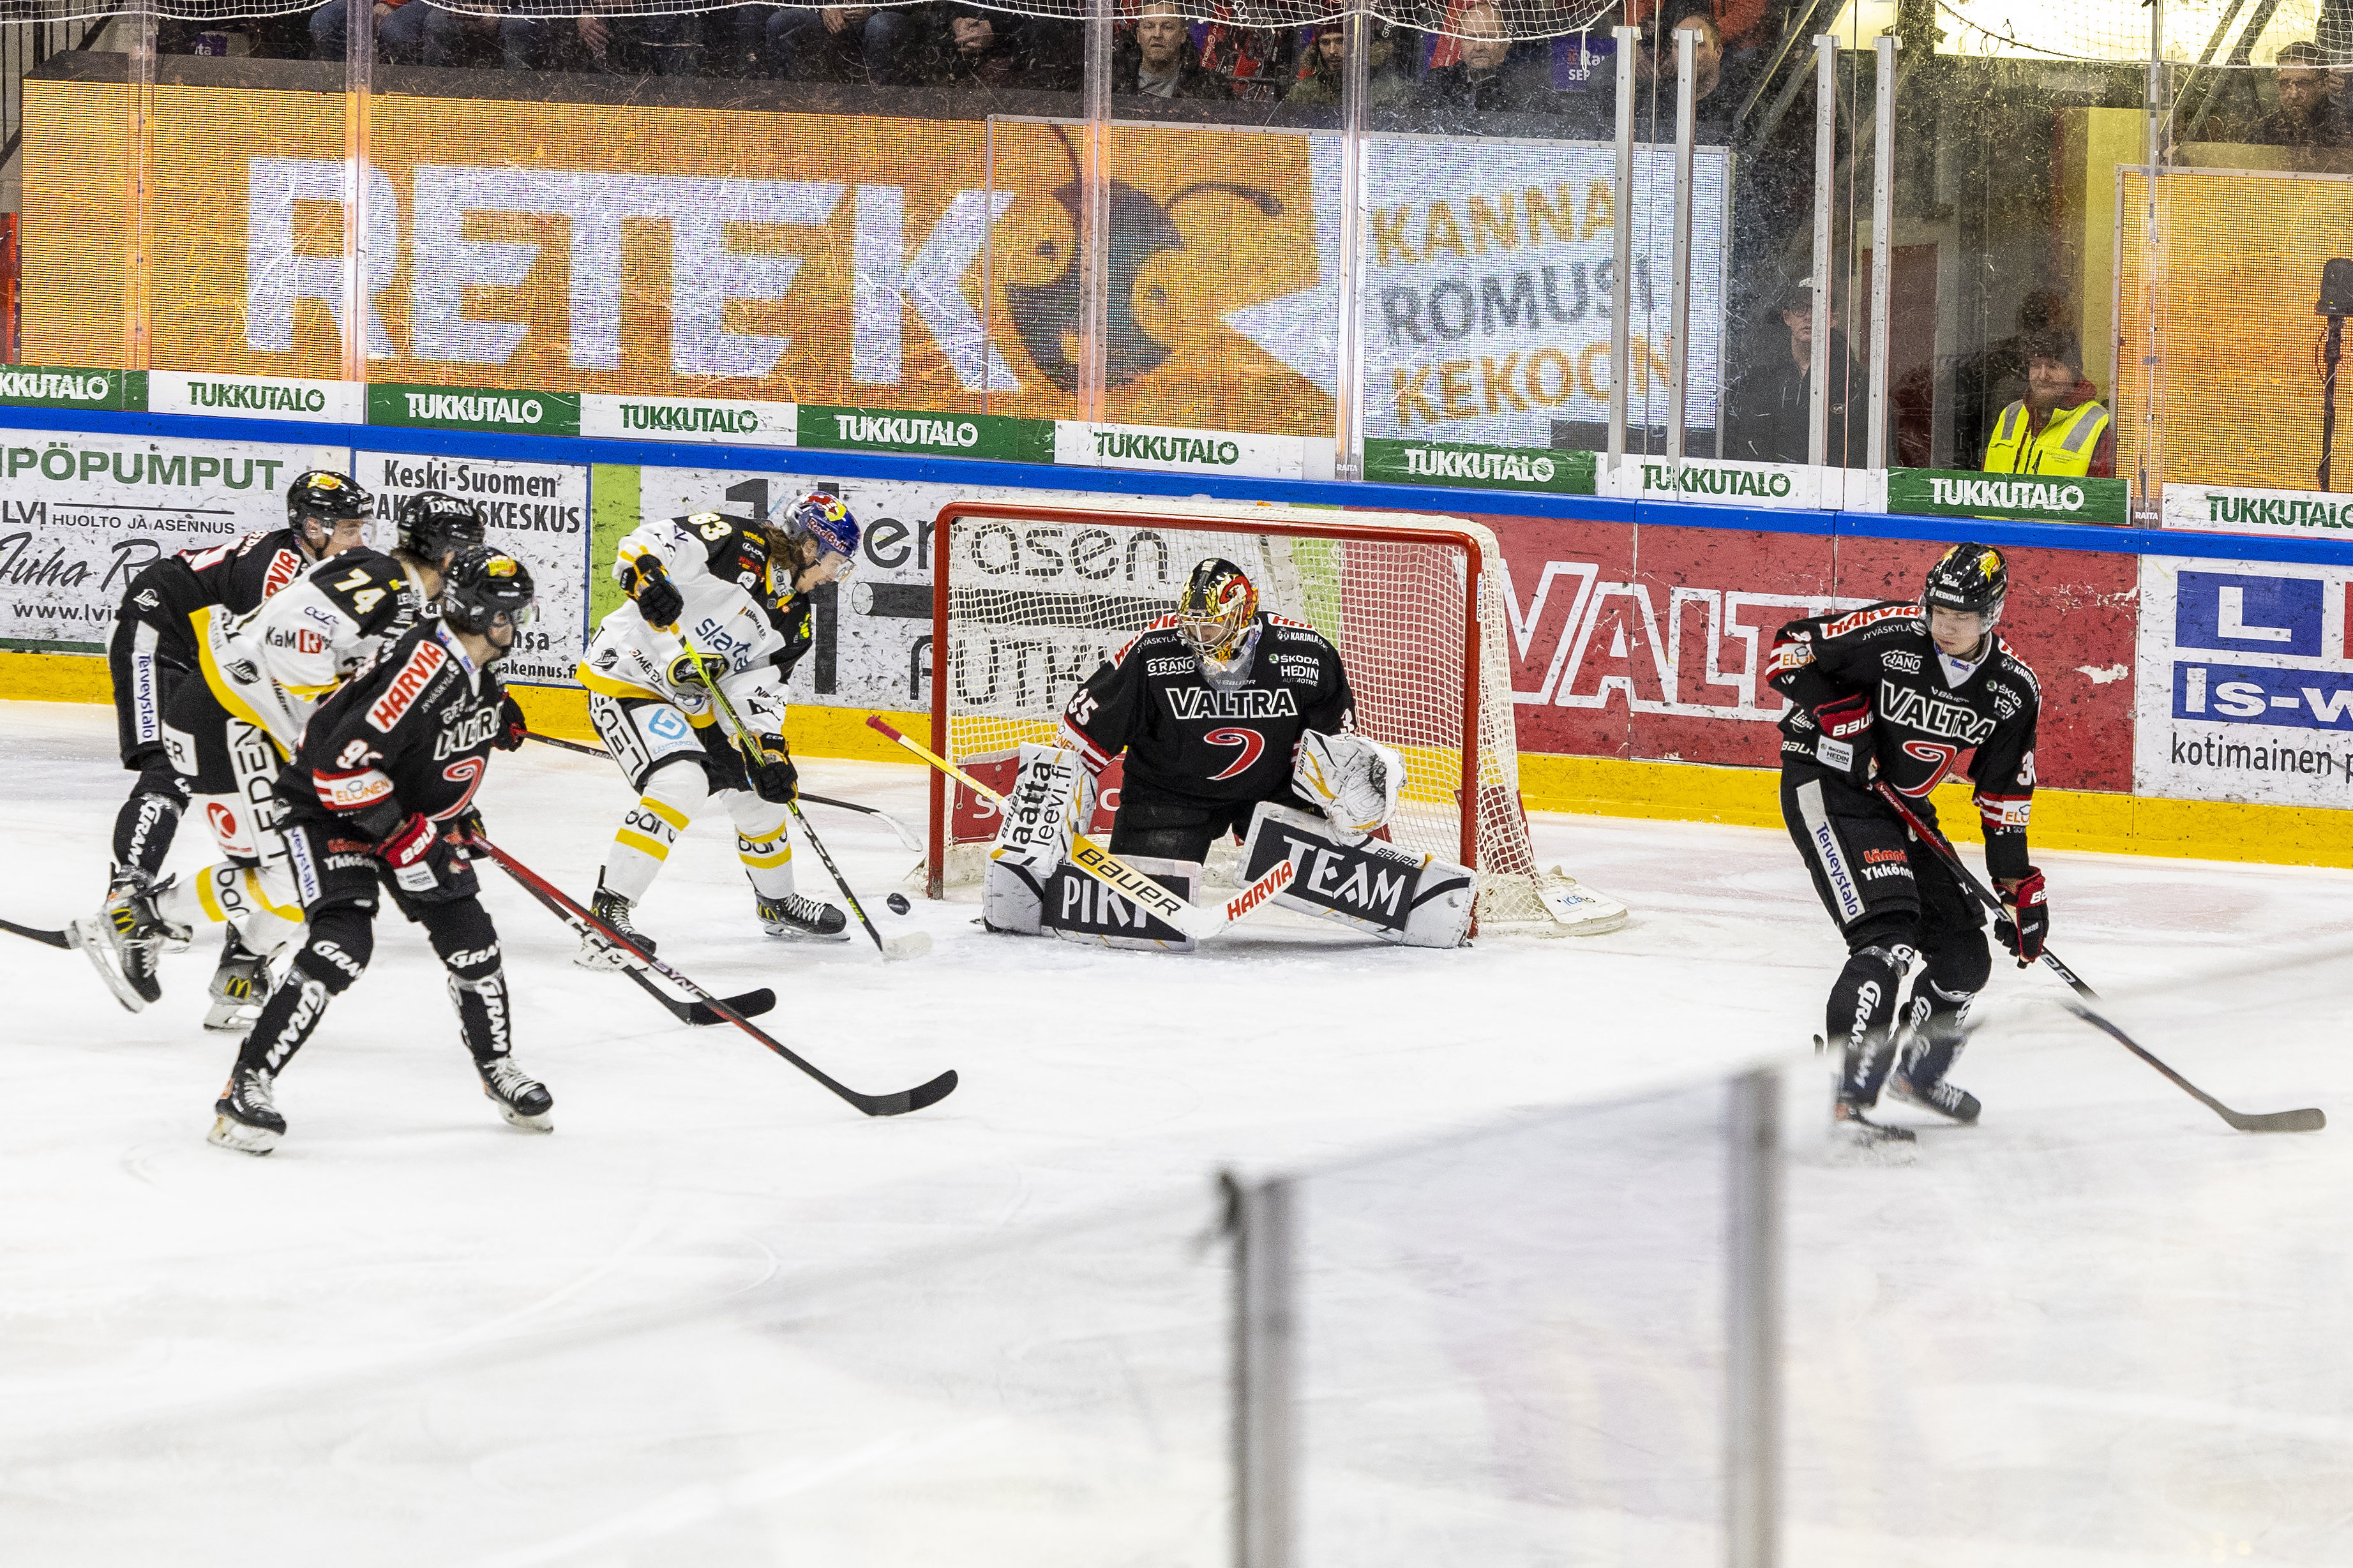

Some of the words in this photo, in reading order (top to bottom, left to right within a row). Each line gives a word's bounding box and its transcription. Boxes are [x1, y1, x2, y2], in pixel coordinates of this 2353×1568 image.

[1372, 180, 1616, 267] KANNA
[246, 156, 1021, 393] RETEK
[1380, 252, 1655, 346] ROMUSI
[0, 372, 109, 400] KKUTALO
[188, 382, 325, 412] TUKKUTALO
[405, 392, 543, 424] TUKKUTALO
[619, 403, 758, 435] TUKKUTALO
[833, 415, 979, 448] TUKKUTALO
[1093, 432, 1240, 465] TUKKUTALO
[0, 442, 283, 491] PÖPUMPUT
[384, 459, 556, 498] Keski-Suomen
[1404, 449, 1555, 482] TUKKUTALO
[1643, 464, 1791, 498] TUKKUTALO
[1930, 477, 2086, 512] TUKKUTALO
[2, 501, 47, 525] LVI
[53, 514, 121, 529] HUOLTO
[127, 519, 148, 530] JA
[153, 519, 235, 535] ASENNUS
[688, 511, 733, 541] 63
[333, 568, 387, 615] 74
[1290, 632, 1319, 645] KARJALA
[1826, 606, 1923, 638] HARVIA
[1862, 623, 1912, 641] JYVÄSKYLÄ
[1497, 558, 1881, 722] VALT
[1148, 659, 1195, 673] GRANO
[1280, 653, 1319, 666] ŠKODA
[1281, 665, 1319, 680] HEDIN
[137, 653, 156, 739] Terveystalo
[373, 641, 446, 730] HARVIA
[1068, 688, 1099, 726] 35
[1165, 686, 1298, 720] VALTRA
[1882, 678, 1997, 745] VALTRA
[1298, 737, 1308, 775] BAUER
[1826, 750, 1849, 763] HEDIN
[2017, 750, 2038, 786] 3
[2171, 732, 2332, 775] kotimainen
[1374, 847, 1419, 868] BAUER
[1815, 821, 1858, 916] Terveystalo
[1076, 847, 1182, 916] BAUER
[1227, 861, 1294, 921] HARVIA
[1282, 835, 1406, 916] TEAM
